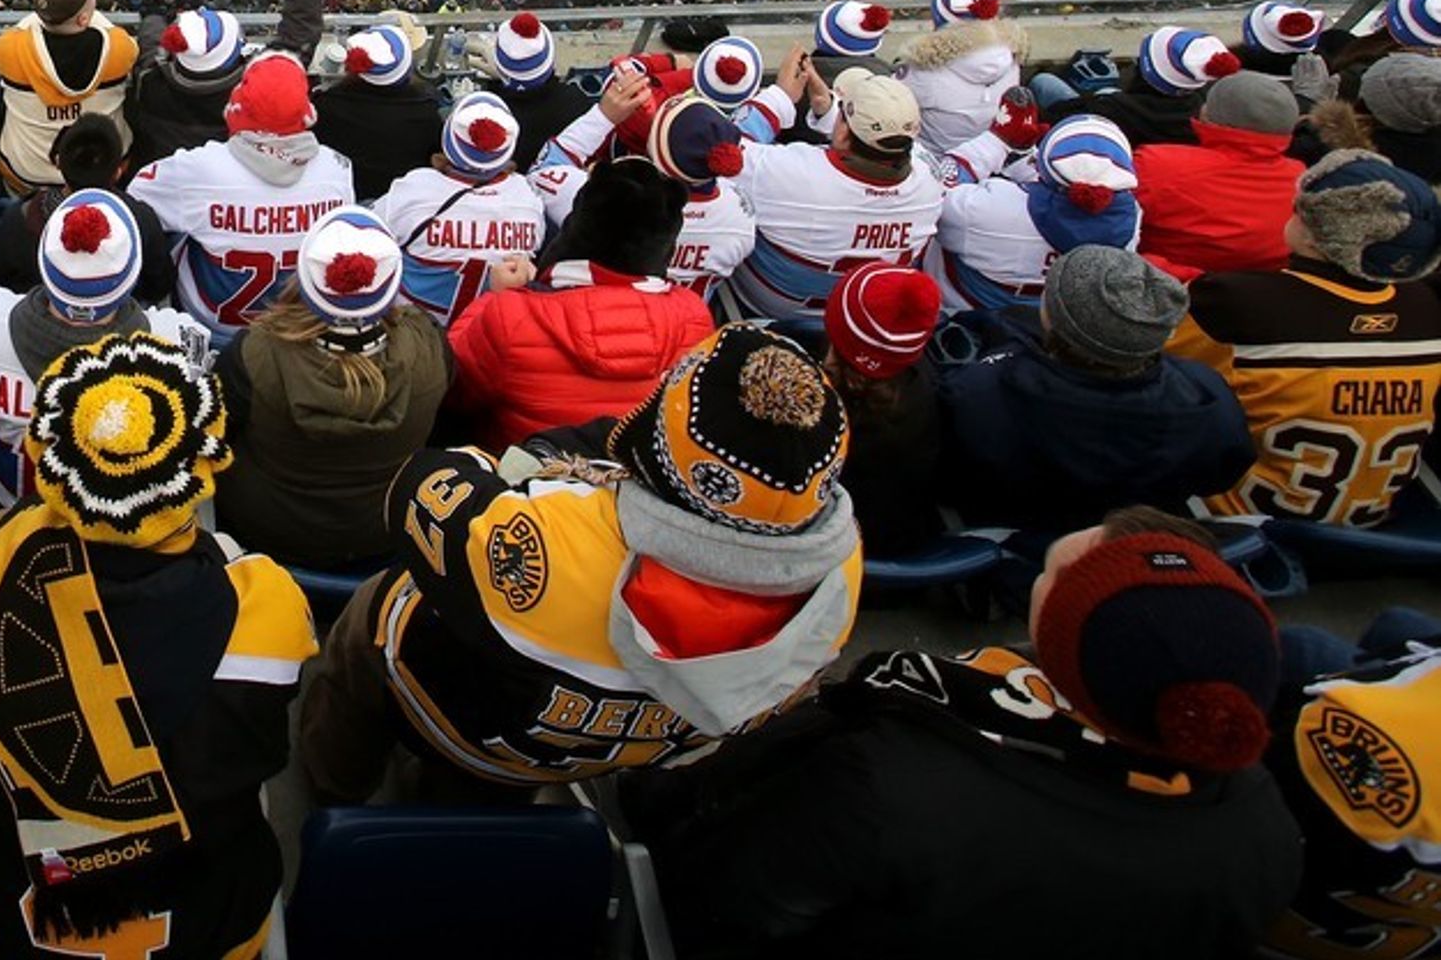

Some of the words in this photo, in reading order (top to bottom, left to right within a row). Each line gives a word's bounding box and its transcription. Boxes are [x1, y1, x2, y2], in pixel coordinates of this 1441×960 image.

[210, 198, 345, 235] GALCHENY
[851, 222, 913, 250] PRICE
[1331, 379, 1424, 416] CHARA
[1241, 417, 1434, 528] 33
[404, 467, 475, 577] 37
[508, 519, 544, 606] BRUINS
[537, 684, 696, 738] BER
[1330, 714, 1410, 818] BRUINS
[63, 838, 153, 874] Reebok
